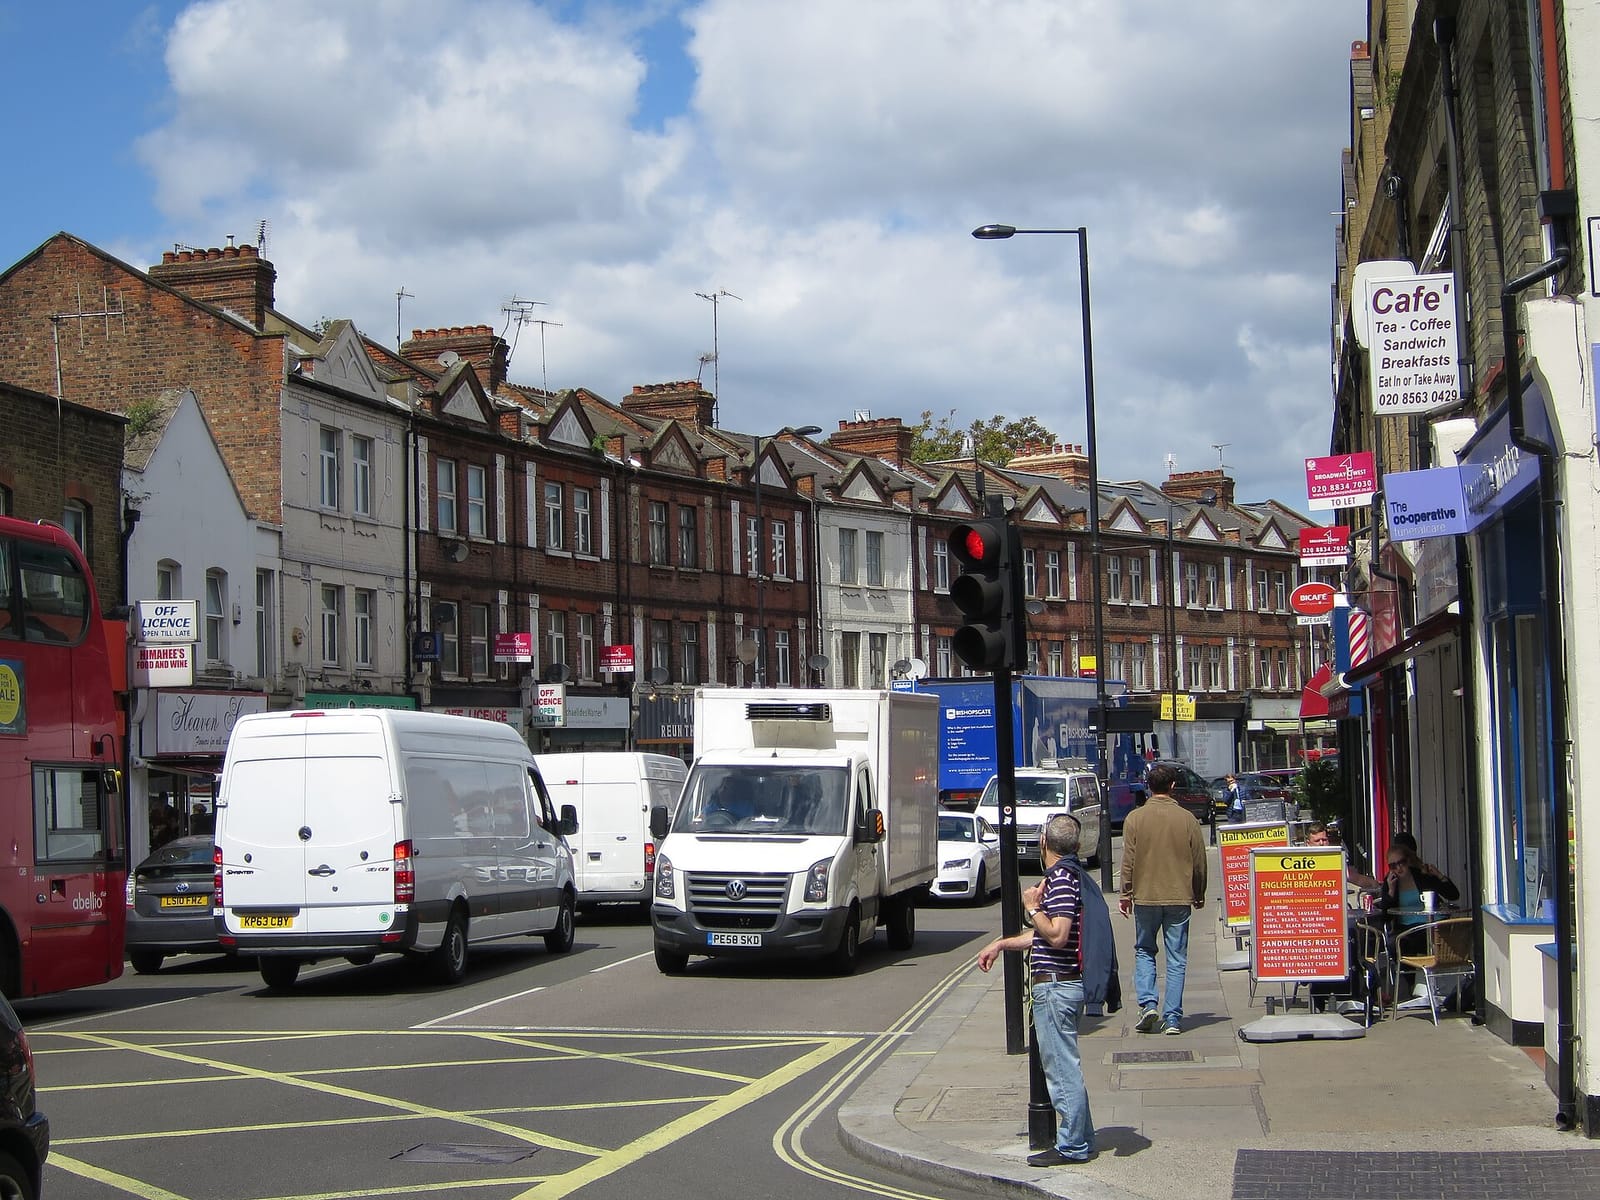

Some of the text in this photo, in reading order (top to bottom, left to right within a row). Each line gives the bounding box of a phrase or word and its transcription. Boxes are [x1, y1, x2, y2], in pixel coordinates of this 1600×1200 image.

[1376, 321, 1397, 333] Tea
[1410, 318, 1451, 331] Coffee
[1384, 336, 1446, 351] Sandwich
[1382, 355, 1450, 369] Breakfasts
[1379, 373, 1456, 387] Eat In or Take Away
[1379, 389, 1458, 406] 020 8563 0429
[1314, 472, 1346, 480] BROADWAY
[1311, 480, 1372, 493] 020 8834 7030
[1331, 497, 1356, 507] TO LET
[1390, 501, 1408, 514] The
[1393, 508, 1456, 525] co-operative
[1394, 522, 1446, 537] funeralcare
[154, 606, 178, 616] OFF
[142, 618, 191, 628] LICENCE
[140, 648, 185, 660] HIMAHEE'S
[137, 660, 188, 669] FOOD AND WINE
[540, 689, 555, 697] OFF
[533, 698, 562, 706] LICENCE
[171, 695, 219, 732] Heaven
[468, 709, 508, 721] LICENCE
[1222, 832, 1239, 842] Half
[1241, 831, 1264, 840] Moon
[1281, 856, 1316, 869] Café
[1228, 874, 1248, 882] FRES
[1261, 880, 1336, 889] ENGLISH BREAKFAST
[73, 892, 103, 910] abellio
[166, 897, 184, 906] LS10
[1230, 899, 1246, 907] TEA
[244, 916, 289, 927] KP63 CBY
[713, 935, 759, 945] PE58 SKD
[1262, 939, 1339, 947] SANDWICHES/ROLLS
